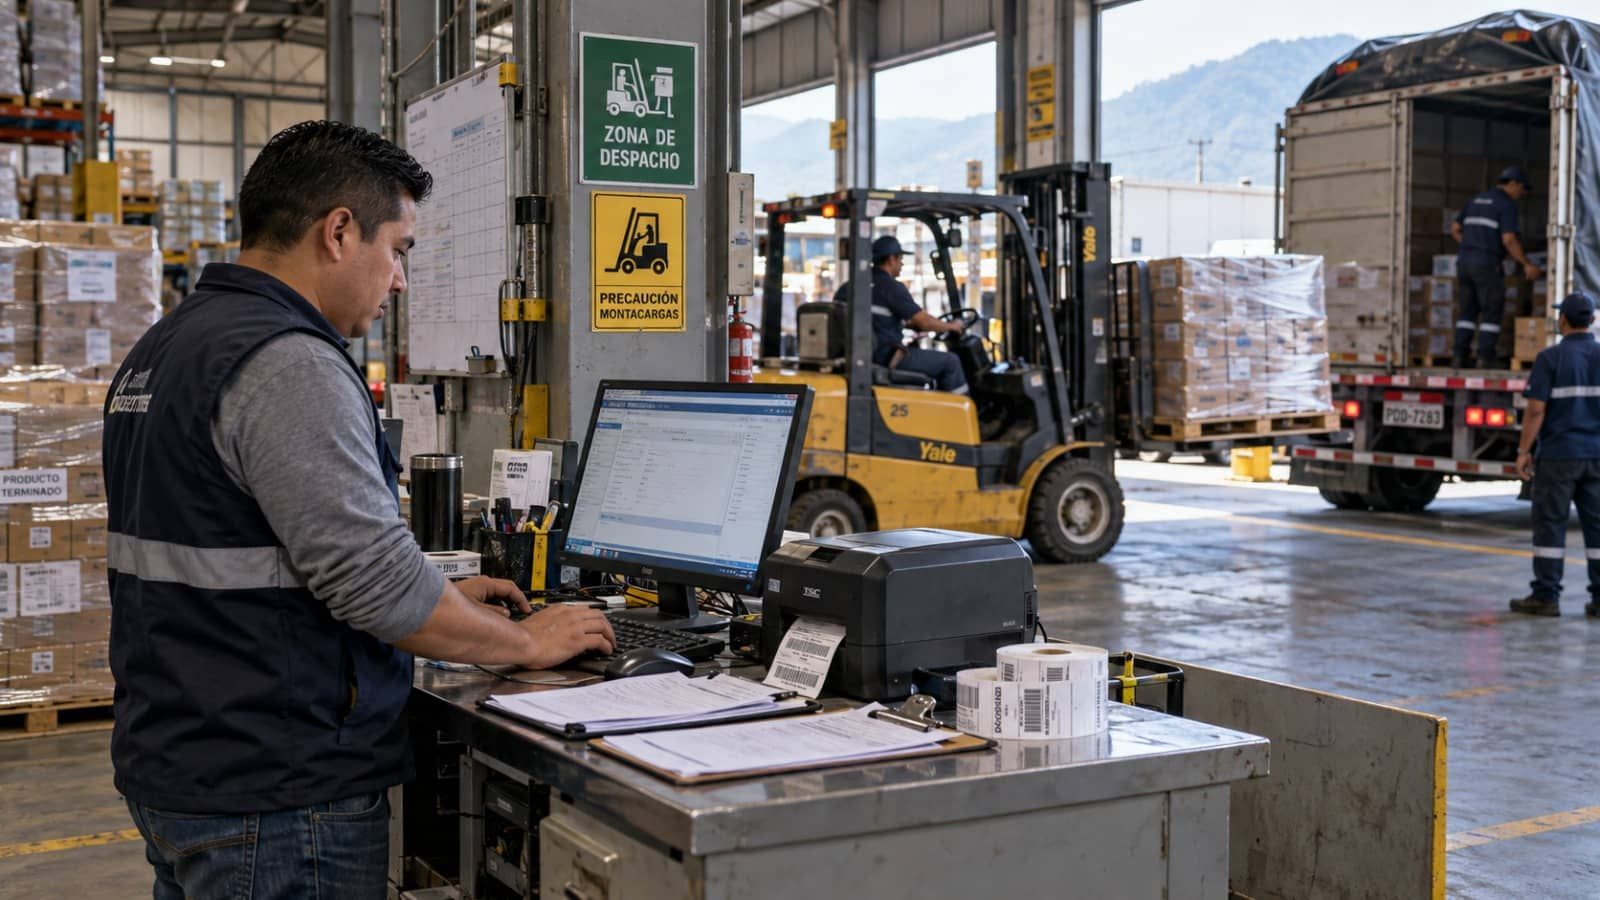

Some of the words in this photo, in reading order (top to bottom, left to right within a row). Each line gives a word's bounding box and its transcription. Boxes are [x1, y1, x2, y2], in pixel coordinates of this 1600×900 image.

[604, 125, 649, 144] ZONA
[656, 128, 676, 146] DE
[600, 148, 680, 170] DESPACHO
[600, 291, 679, 304] PRECAUCIÓN
[600, 308, 679, 320] MONTACARGAS
[890, 403, 909, 417] 25
[920, 441, 957, 463] Yale
[3, 474, 60, 484] PRODUCTO
[2, 486, 62, 497] TERMINADO
